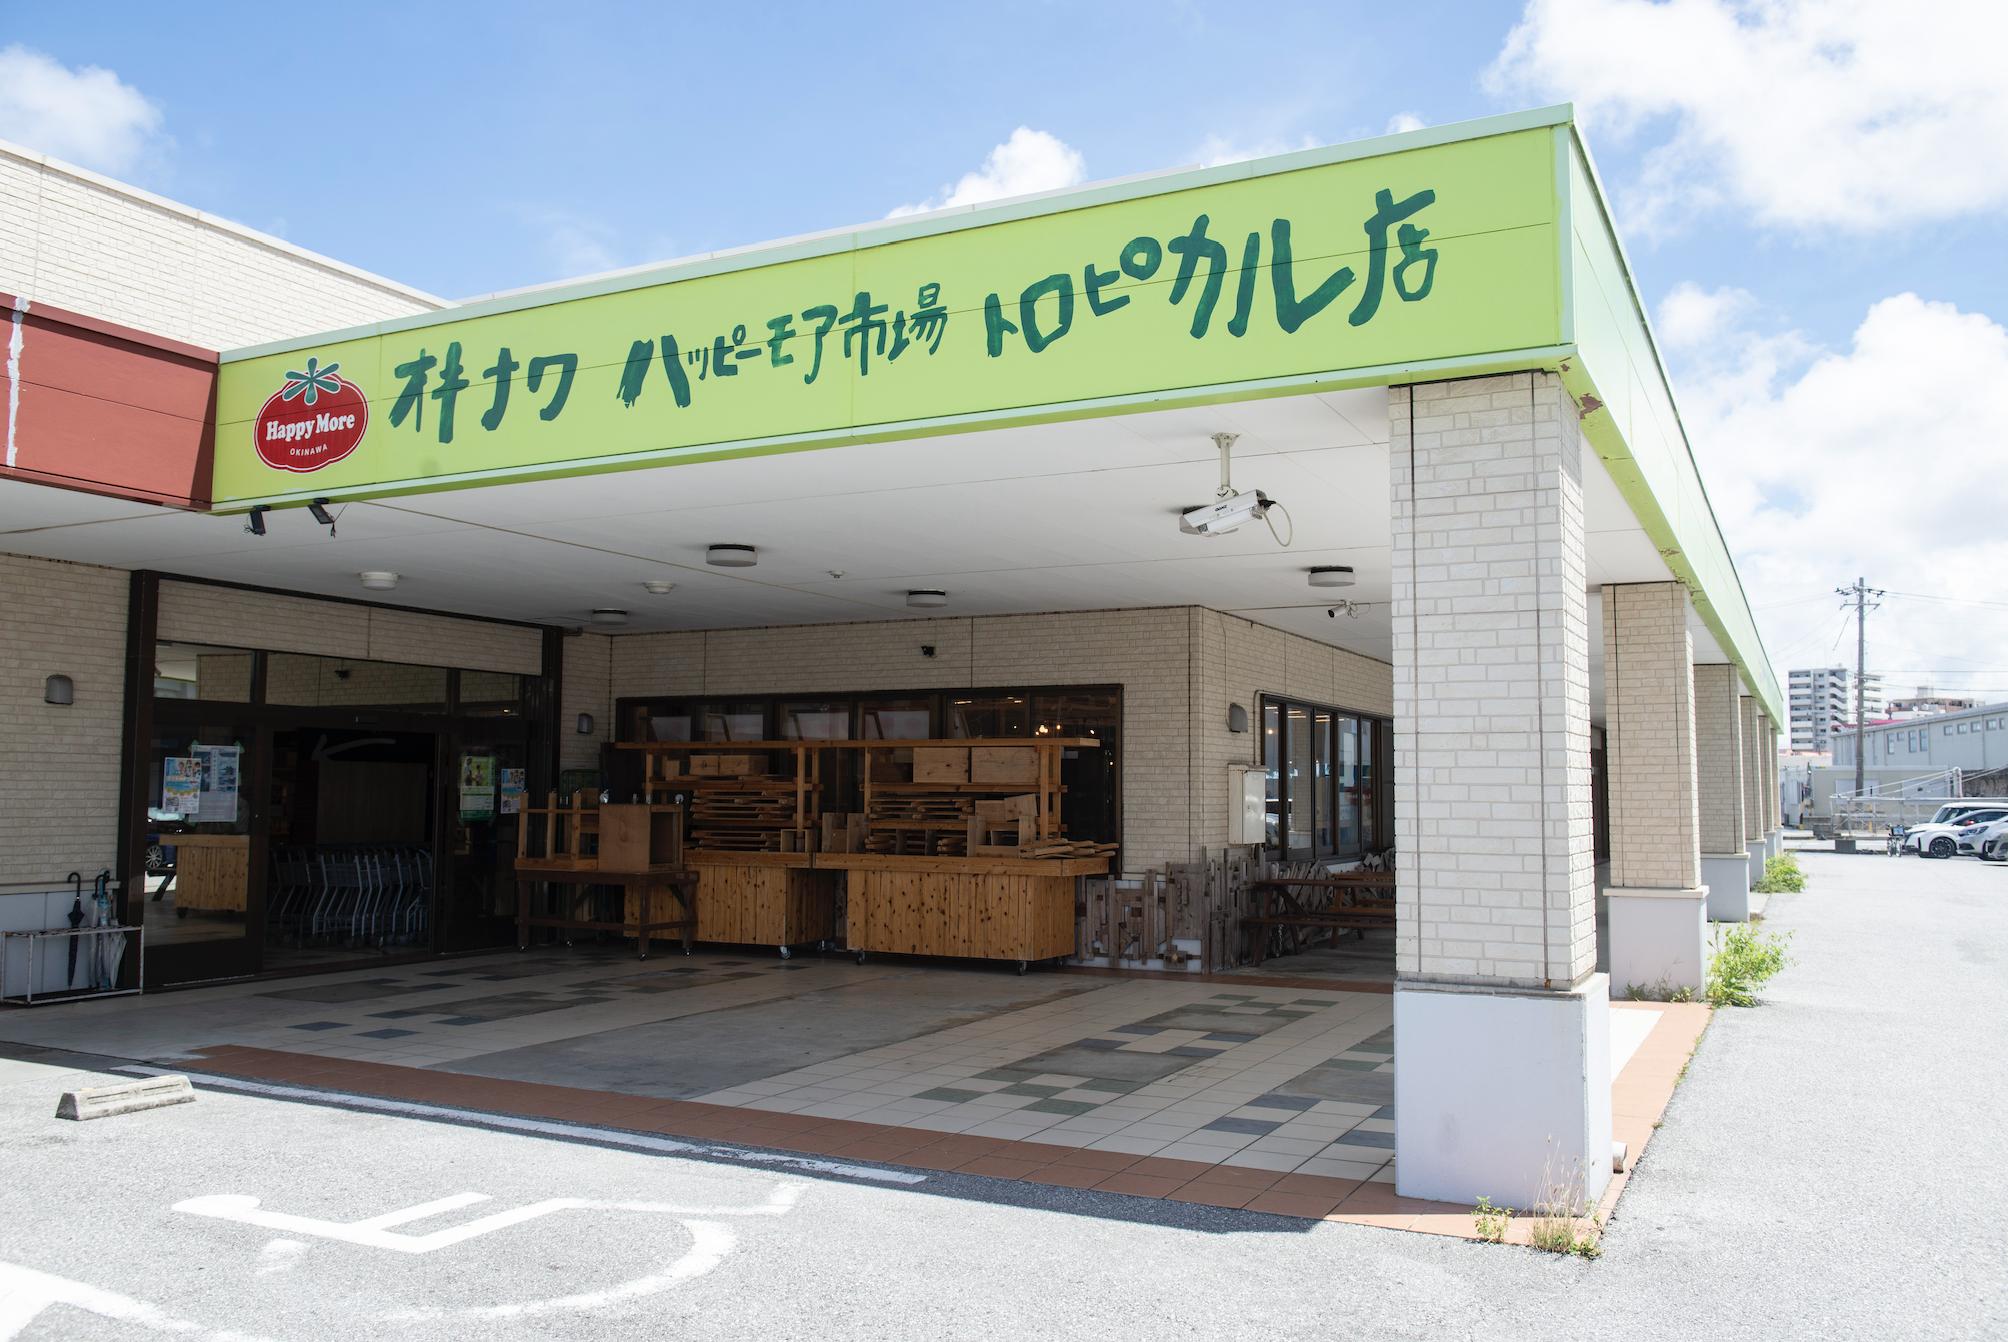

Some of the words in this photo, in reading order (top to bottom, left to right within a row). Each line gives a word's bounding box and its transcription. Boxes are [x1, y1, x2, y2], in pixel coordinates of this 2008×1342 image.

[390, 341, 577, 443] オキナワ
[616, 282, 948, 407] ハッピーモア市場
[984, 188, 1438, 358] トロピカル店
[266, 420, 315, 442] Happy
[315, 412, 355, 434] More
[289, 443, 328, 456] OKINAWA
